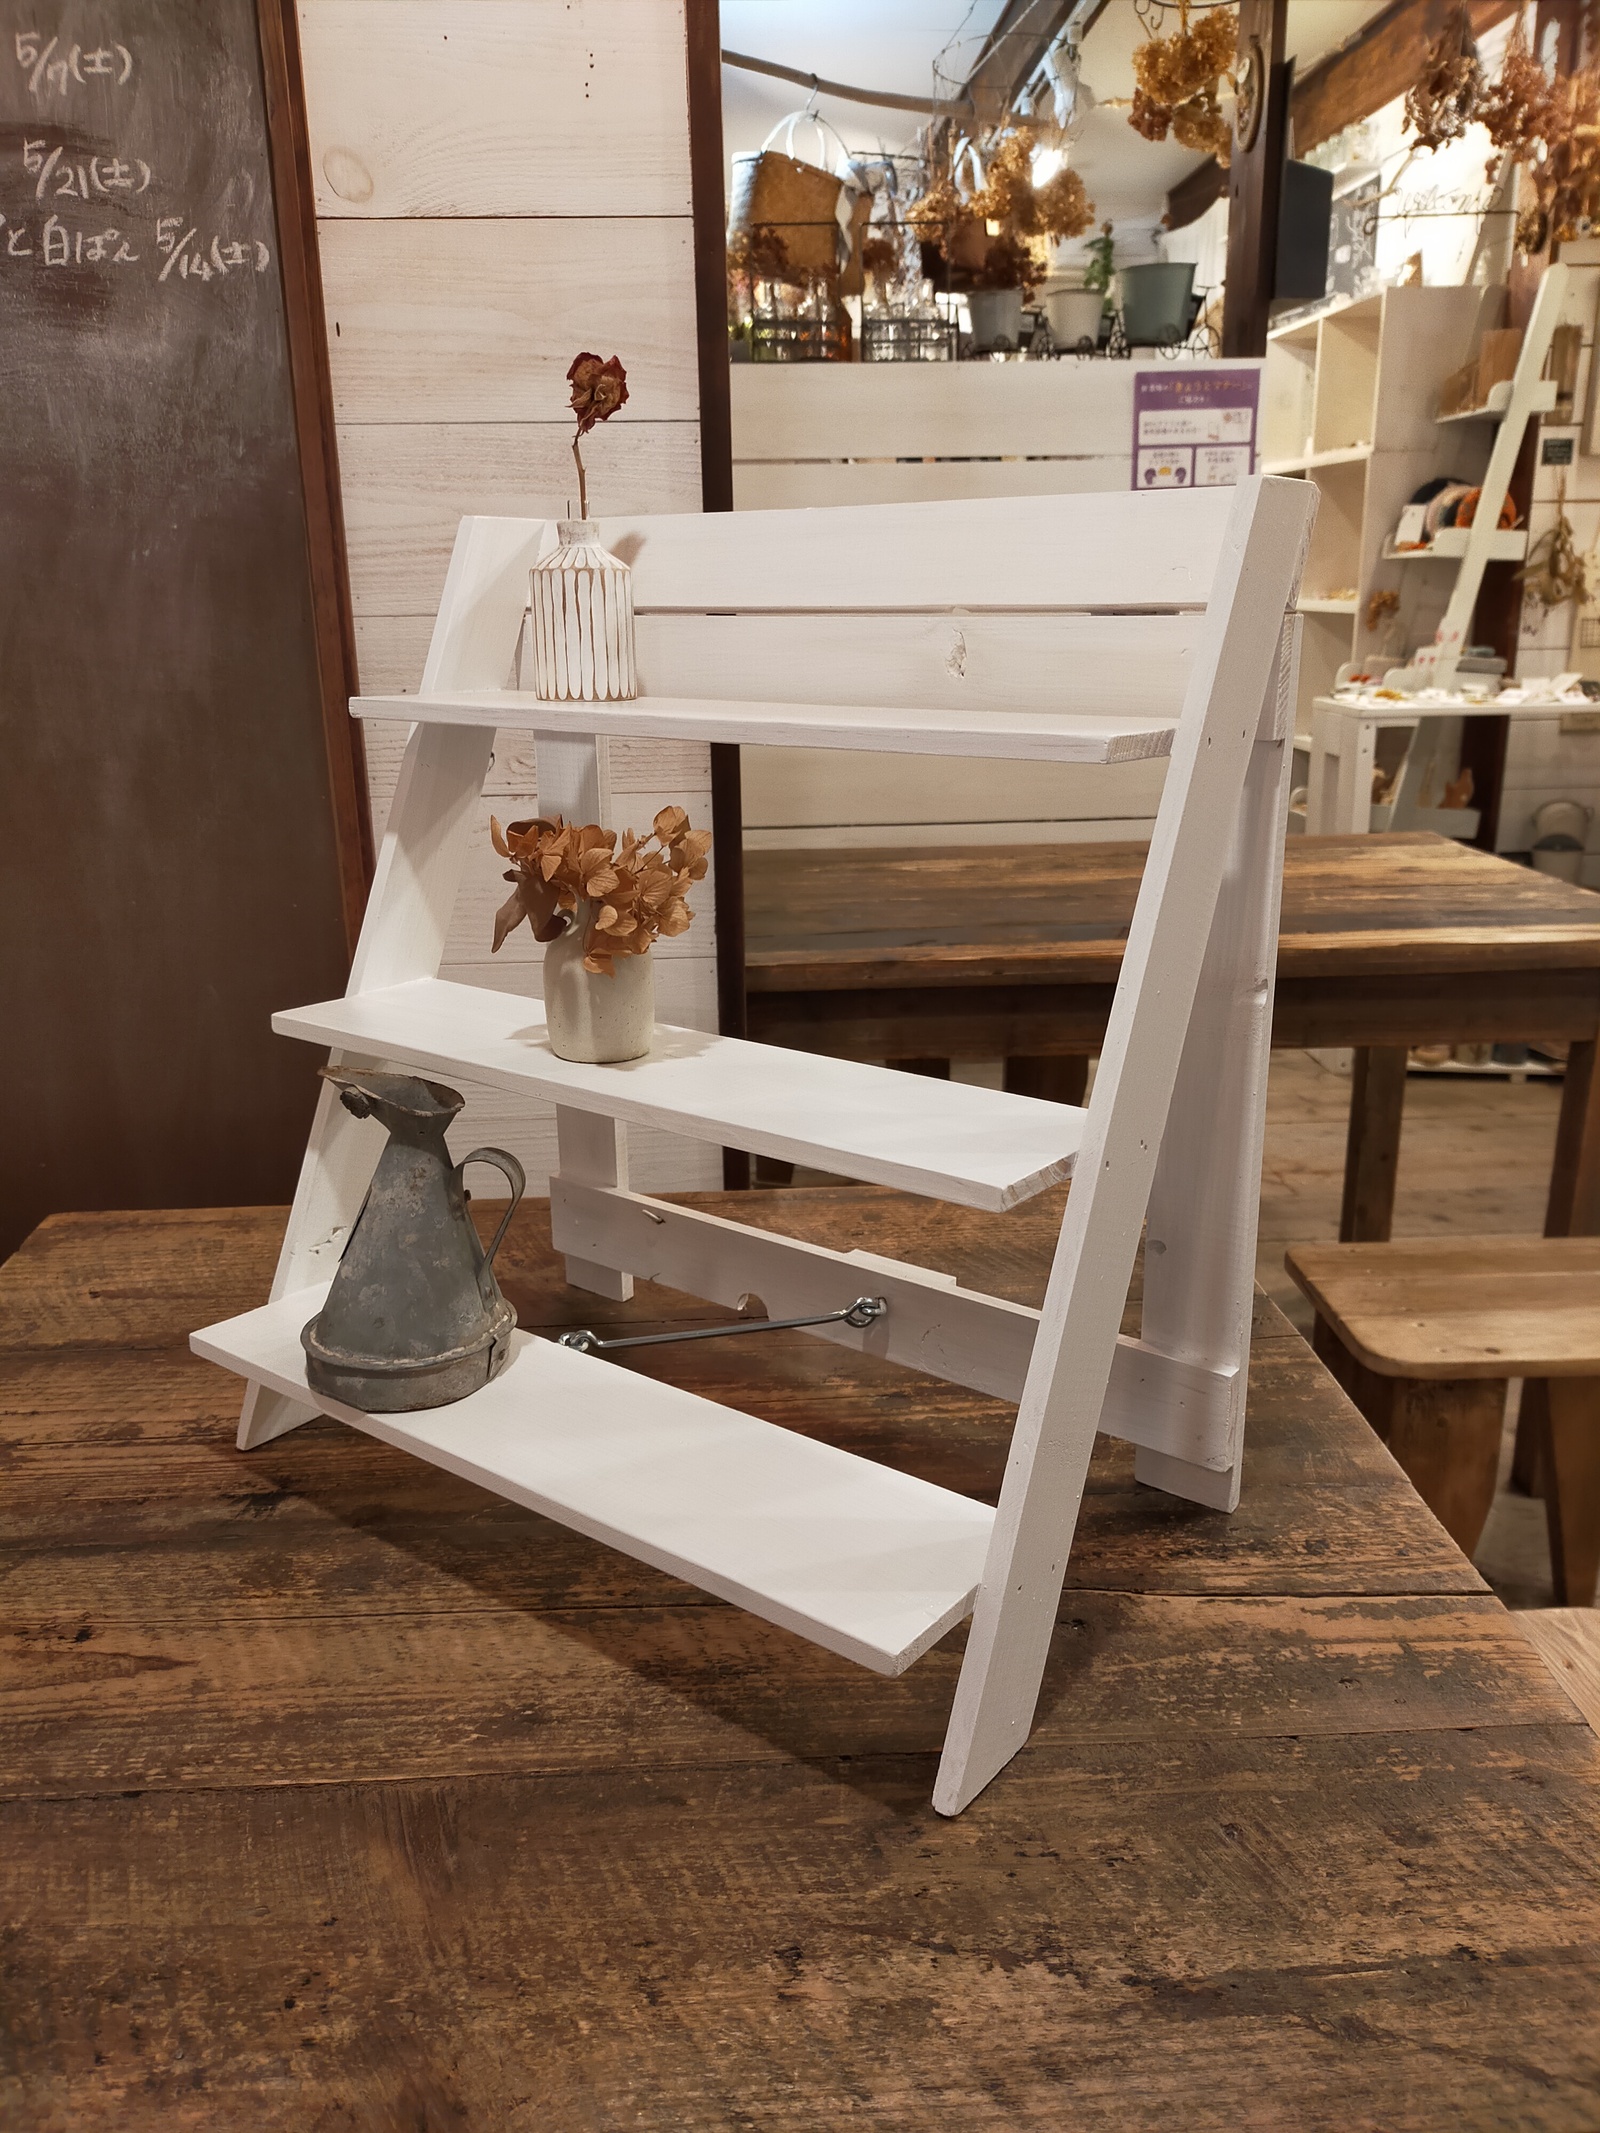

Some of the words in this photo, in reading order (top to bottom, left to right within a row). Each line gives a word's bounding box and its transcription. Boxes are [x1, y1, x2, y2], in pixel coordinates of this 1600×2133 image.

[23, 137, 151, 200] 5/21(土)
[0, 213, 140, 267] と白ぱん
[156, 216, 270, 282] 5/14(土)
